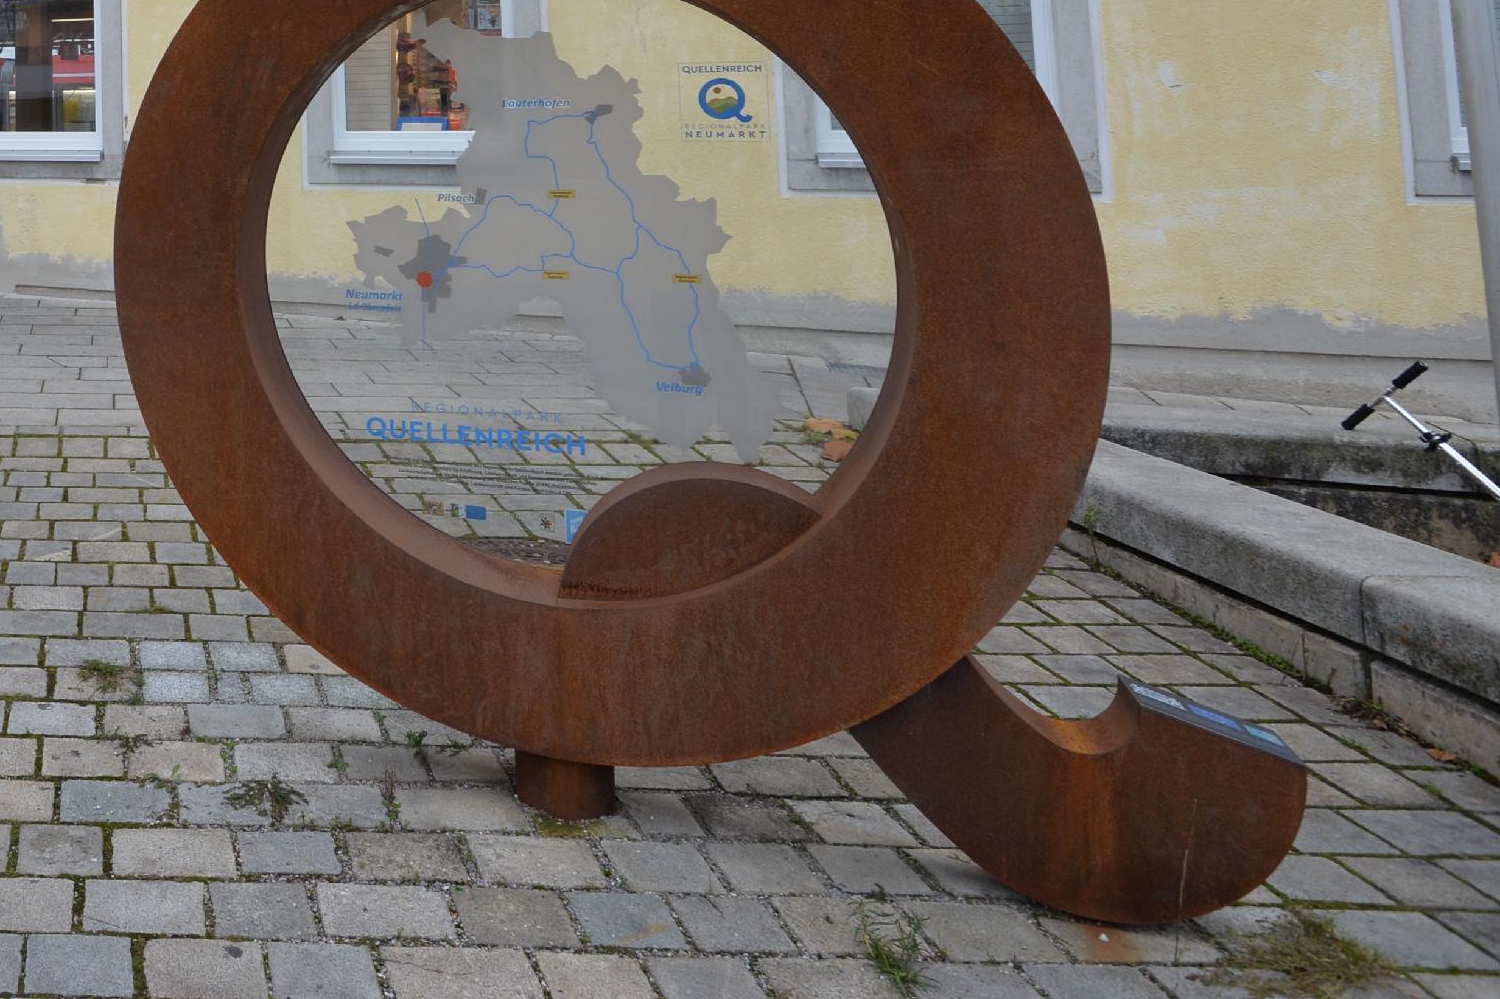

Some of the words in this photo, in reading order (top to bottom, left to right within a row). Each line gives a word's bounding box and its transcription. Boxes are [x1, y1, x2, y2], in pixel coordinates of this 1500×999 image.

[682, 65, 762, 74] QUELLENREICH
[502, 98, 571, 108] Lauterhofen
[685, 130, 766, 138] NEUMARKT
[437, 193, 475, 202] Pilsach
[345, 289, 404, 301] Neumarkt
[656, 382, 703, 396] Velburg
[411, 402, 563, 423] REGIONALPARK
[366, 416, 587, 456] QUELLENREICH
